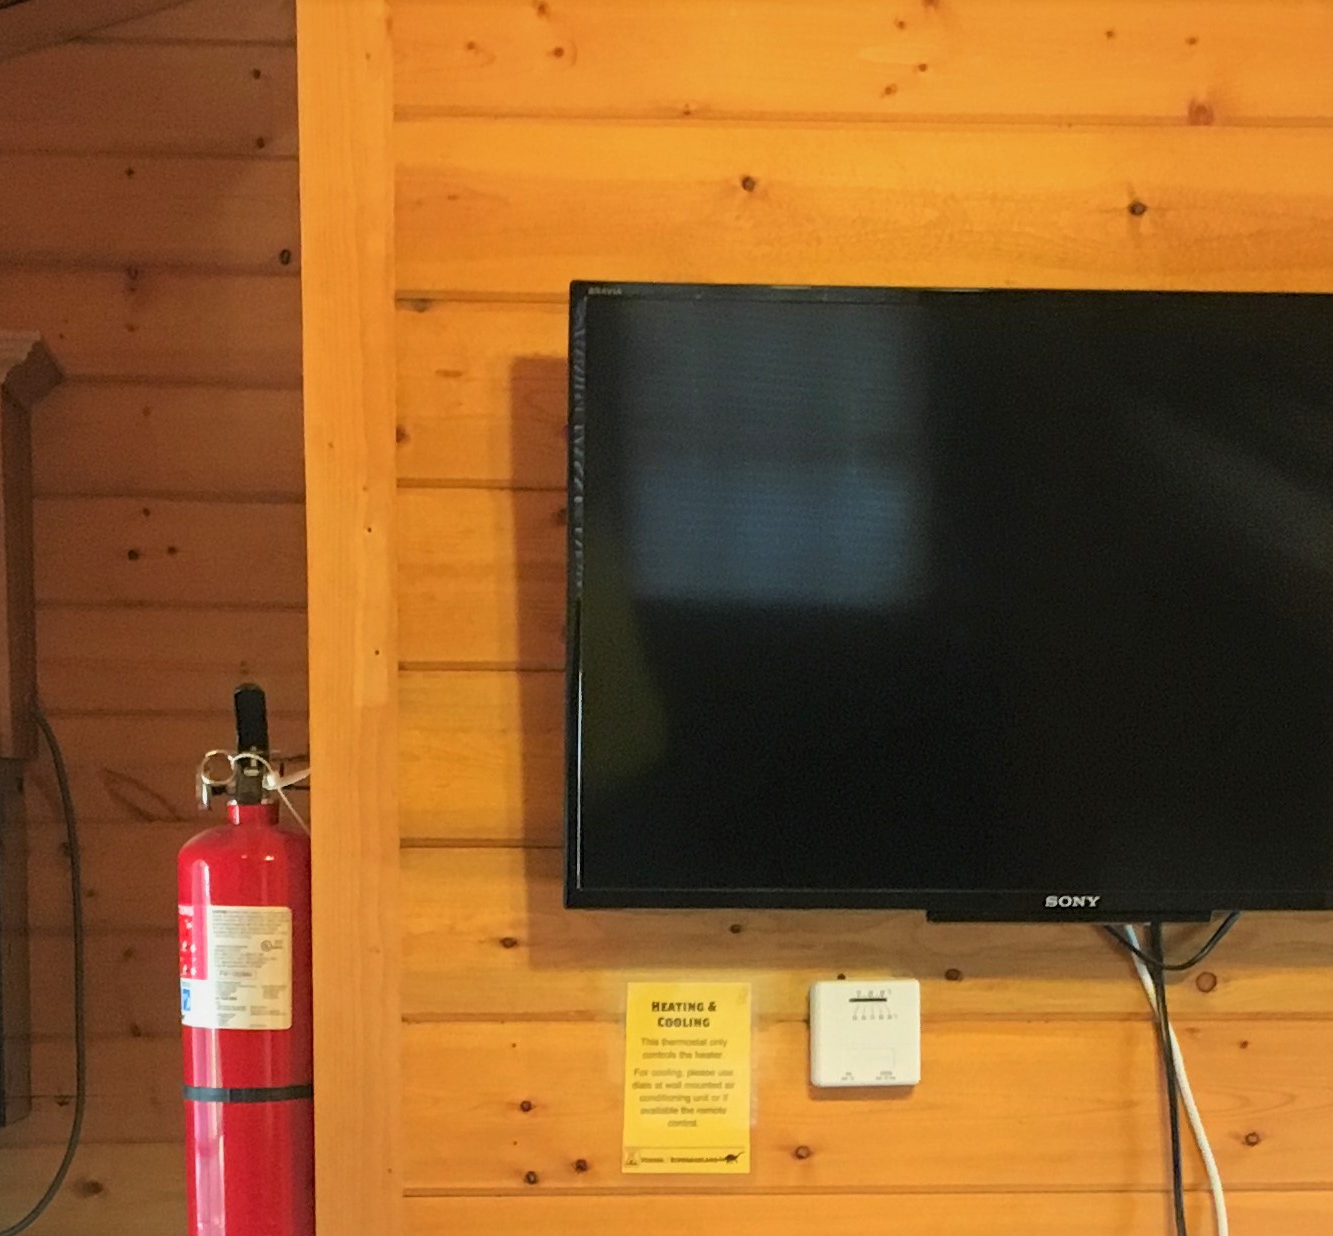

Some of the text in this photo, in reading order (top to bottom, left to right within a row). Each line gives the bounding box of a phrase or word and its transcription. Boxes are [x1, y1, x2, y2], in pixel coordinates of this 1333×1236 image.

[1045, 895, 1101, 908] SONY
[651, 1001, 717, 1012] HEATING &
[657, 1018, 710, 1028] COOLING
[641, 1038, 727, 1048] This thermostat only
[642, 1051, 676, 1059] controls
[679, 1051, 692, 1059] the
[634, 1068, 648, 1076] For
[687, 1069, 715, 1078] please
[639, 1094, 691, 1103] conditioning
[693, 1094, 709, 1102] unit
